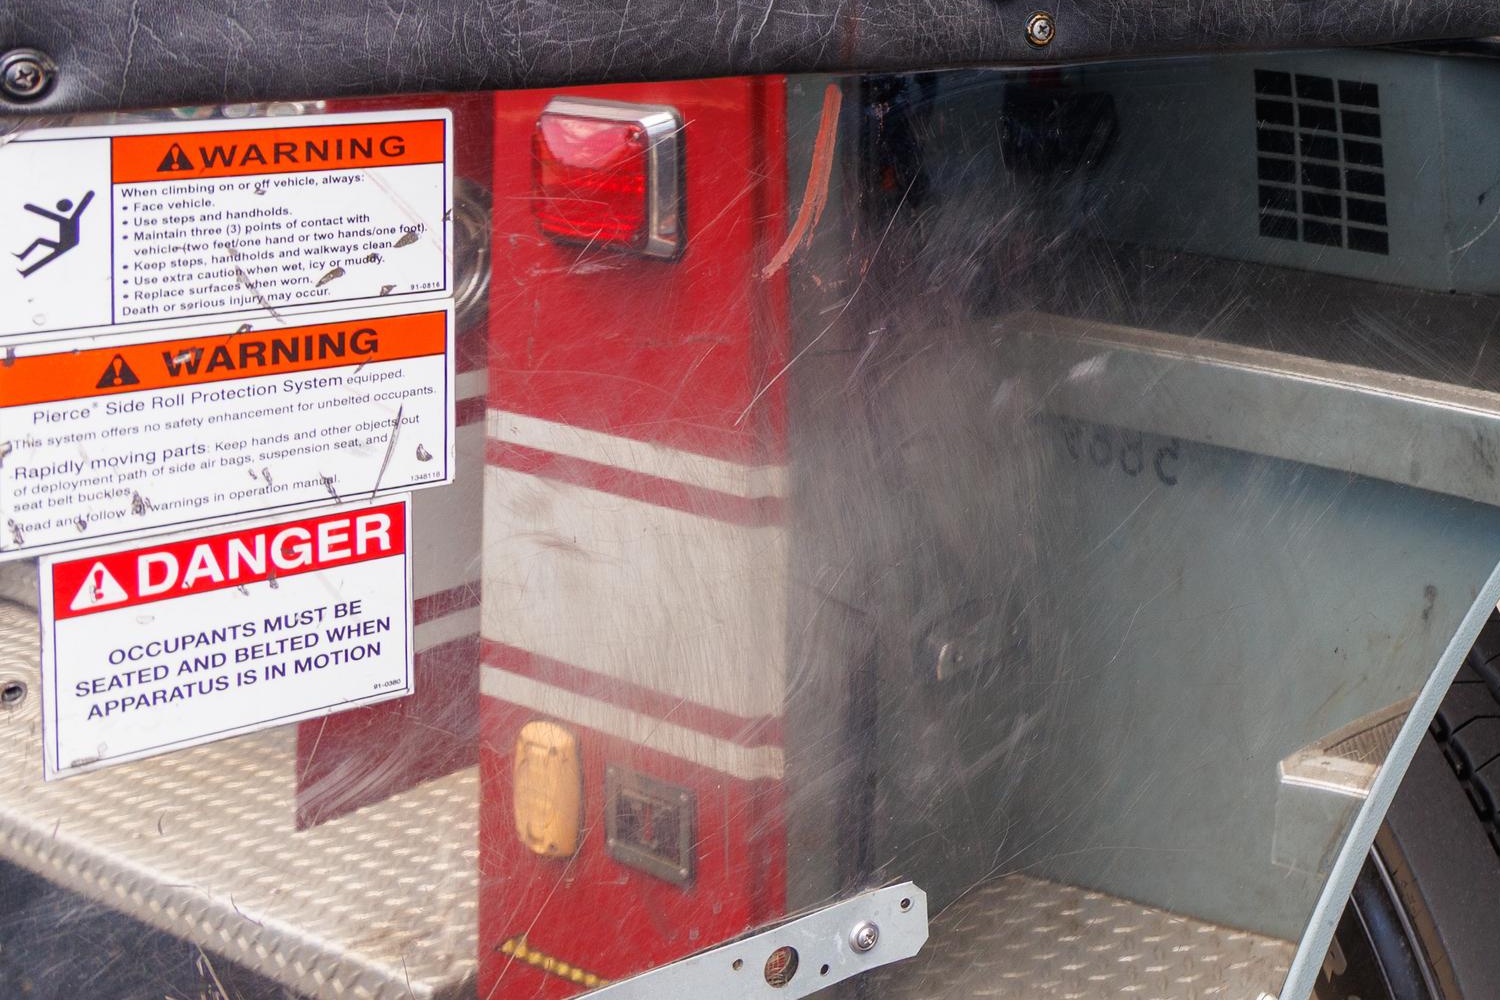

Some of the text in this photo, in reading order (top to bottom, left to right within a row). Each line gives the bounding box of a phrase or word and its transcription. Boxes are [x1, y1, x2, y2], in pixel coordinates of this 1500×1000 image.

[199, 135, 406, 169] WARNING
[120, 174, 366, 198] When climbing on or off vehicle, always:
[133, 197, 216, 212] Face vehicle.
[133, 206, 294, 227] Use steps and handholds.
[133, 213, 371, 241] Maintain three (3) points of contact with
[133, 222, 429, 256] vehicle (two feet/one hand or two hands/one foot).
[133, 261, 166, 272] Keep
[170, 258, 207, 269] steps,
[211, 249, 275, 264] handholds
[278, 247, 300, 258] and
[303, 243, 359, 256] walkways
[133, 275, 158, 286] Use
[161, 273, 194, 283] extra
[196, 267, 243, 280] caution
[246, 265, 278, 275] when
[281, 261, 305, 272] wet,
[308, 260, 325, 271] icy
[328, 259, 341, 268] or
[121, 288, 331, 317] Death or serious injury may occur.
[133, 276, 313, 301] Replace surfaces when worn.
[162, 328, 379, 377] WARNING
[104, 399, 146, 415] Side
[150, 393, 185, 409] Roll
[190, 384, 278, 404] Protection
[282, 376, 343, 395] System
[346, 369, 406, 386] equipped.
[13, 386, 437, 449] This system offers no safety enhancement for unbelted occupants.
[12, 432, 389, 497] of deployment path of side air bags, suspension seat, and
[13, 460, 85, 481] Rapidly
[90, 451, 157, 470] moving
[214, 440, 248, 452] Keep
[250, 433, 290, 447] hands
[292, 428, 317, 441] and
[319, 425, 351, 437] other
[400, 414, 421, 425] out
[13, 499, 43, 512] seat
[47, 495, 73, 508] belt
[56, 514, 82, 528] and
[86, 509, 126, 523] follow
[150, 496, 210, 512] warnings
[213, 493, 225, 502] in
[228, 482, 288, 501] operation
[137, 512, 392, 597] DANGER
[108, 599, 363, 665] OCCUPANTS MUST BE
[74, 616, 391, 698] SEATED AND BELTED WHEN
[86, 641, 382, 721] APPARATUS IS IN MOTION
